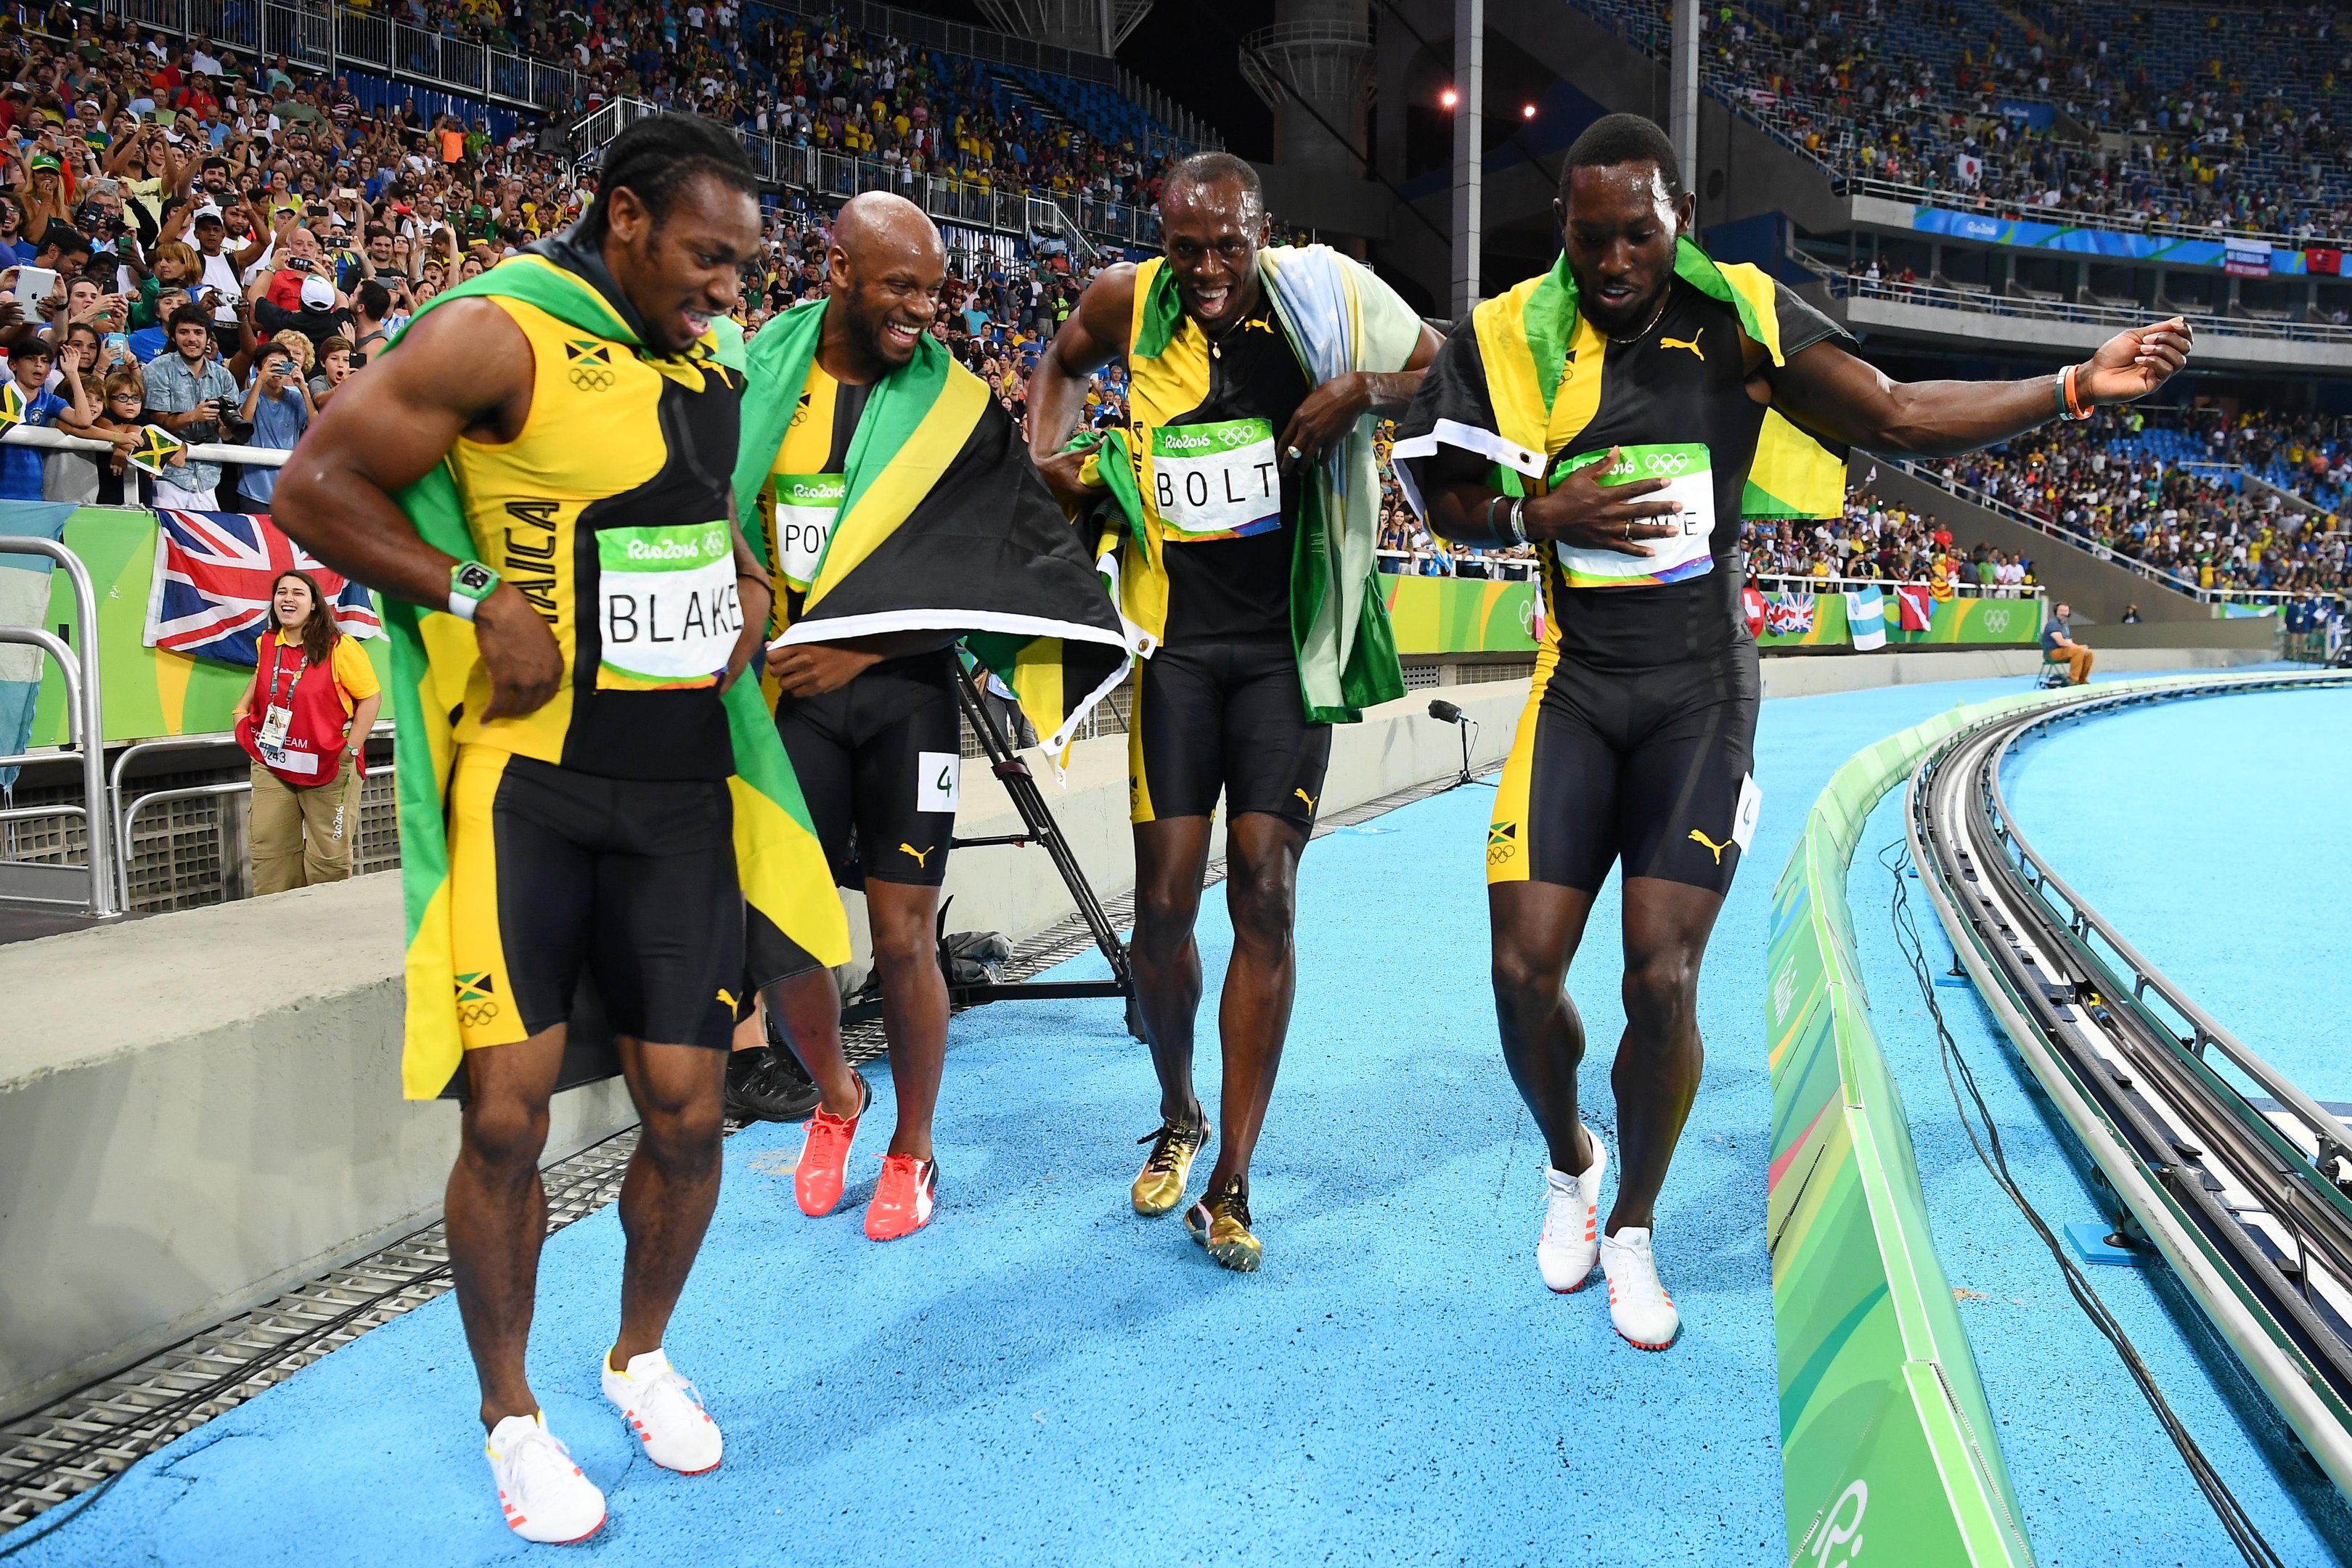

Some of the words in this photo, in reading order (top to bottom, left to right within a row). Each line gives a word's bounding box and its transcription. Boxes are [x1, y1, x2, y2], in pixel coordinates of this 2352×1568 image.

[1164, 432, 1210, 449] Rio2016
[1157, 462, 1274, 507] BOLT
[505, 502, 560, 624] AICA
[627, 538, 700, 561] Rio2016
[608, 583, 745, 644] BLAKE
[284, 736, 309, 749] EAM
[936, 764, 953, 799] 4
[332, 805, 345, 841] Rio2016
